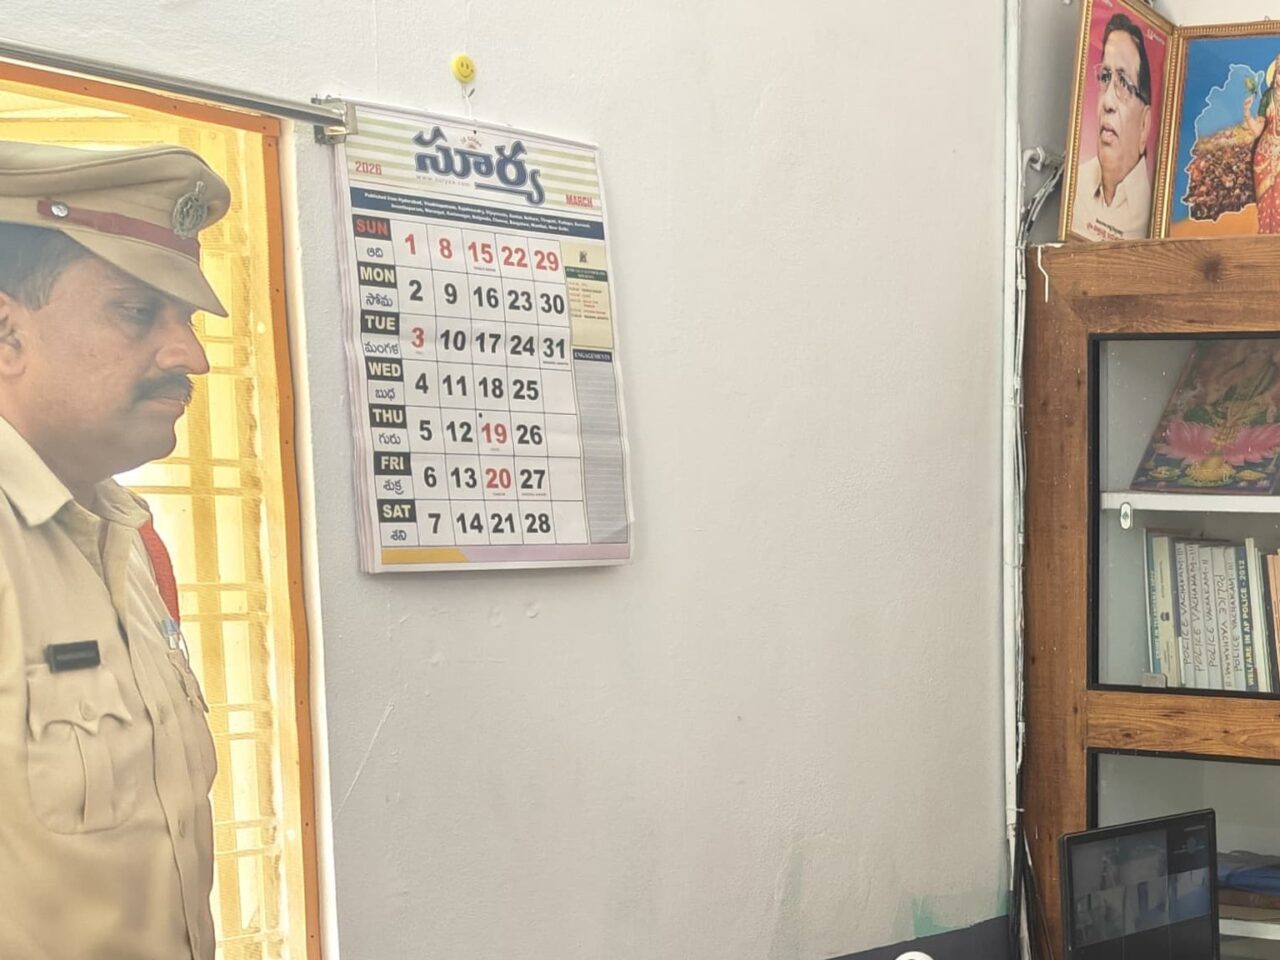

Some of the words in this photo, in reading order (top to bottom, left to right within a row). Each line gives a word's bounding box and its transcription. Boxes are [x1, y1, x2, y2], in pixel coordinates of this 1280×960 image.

[354, 160, 383, 176] 2026
[565, 194, 593, 208] MARCH
[356, 219, 388, 236] SUN
[405, 233, 416, 255] 1
[438, 238, 453, 259] 8
[468, 242, 493, 264] 15
[501, 246, 528, 268] 22
[534, 250, 559, 272] 29
[360, 266, 395, 283] MON
[409, 280, 424, 302] 2
[444, 283, 458, 305] 9
[473, 286, 499, 309] 16
[507, 290, 533, 312] 23
[540, 293, 565, 315] 30
[365, 315, 396, 330] TUE
[411, 327, 425, 348] 3
[440, 329, 466, 351] 10
[475, 332, 501, 354] 17
[510, 335, 535, 356] 24
[543, 337, 565, 359] 31
[367, 362, 401, 377] WED
[415, 373, 429, 394] 4
[442, 375, 467, 397] 11
[479, 377, 504, 399] 18
[512, 379, 539, 401] 25
[372, 408, 403, 423] THU
[419, 420, 432, 441] 5
[446, 420, 473, 443] 12
[481, 422, 508, 444] 19
[516, 424, 543, 445] 26
[381, 456, 404, 470] FRI
[423, 466, 437, 488] 6
[450, 467, 477, 489] 13
[485, 468, 512, 489] 20
[520, 469, 546, 489] 27
[382, 504, 411, 518] SAT
[428, 513, 441, 534] 7
[456, 513, 483, 534] 14
[491, 513, 515, 533] 21
[524, 513, 551, 533] 28
[1215, 574, 1226, 615] POLICE
[1241, 587, 1249, 619] POLICE
[1243, 620, 1250, 632] AP
[1244, 634, 1252, 644] IN
[1232, 635, 1243, 672] POLICE
[1246, 646, 1255, 686] WELFARE
